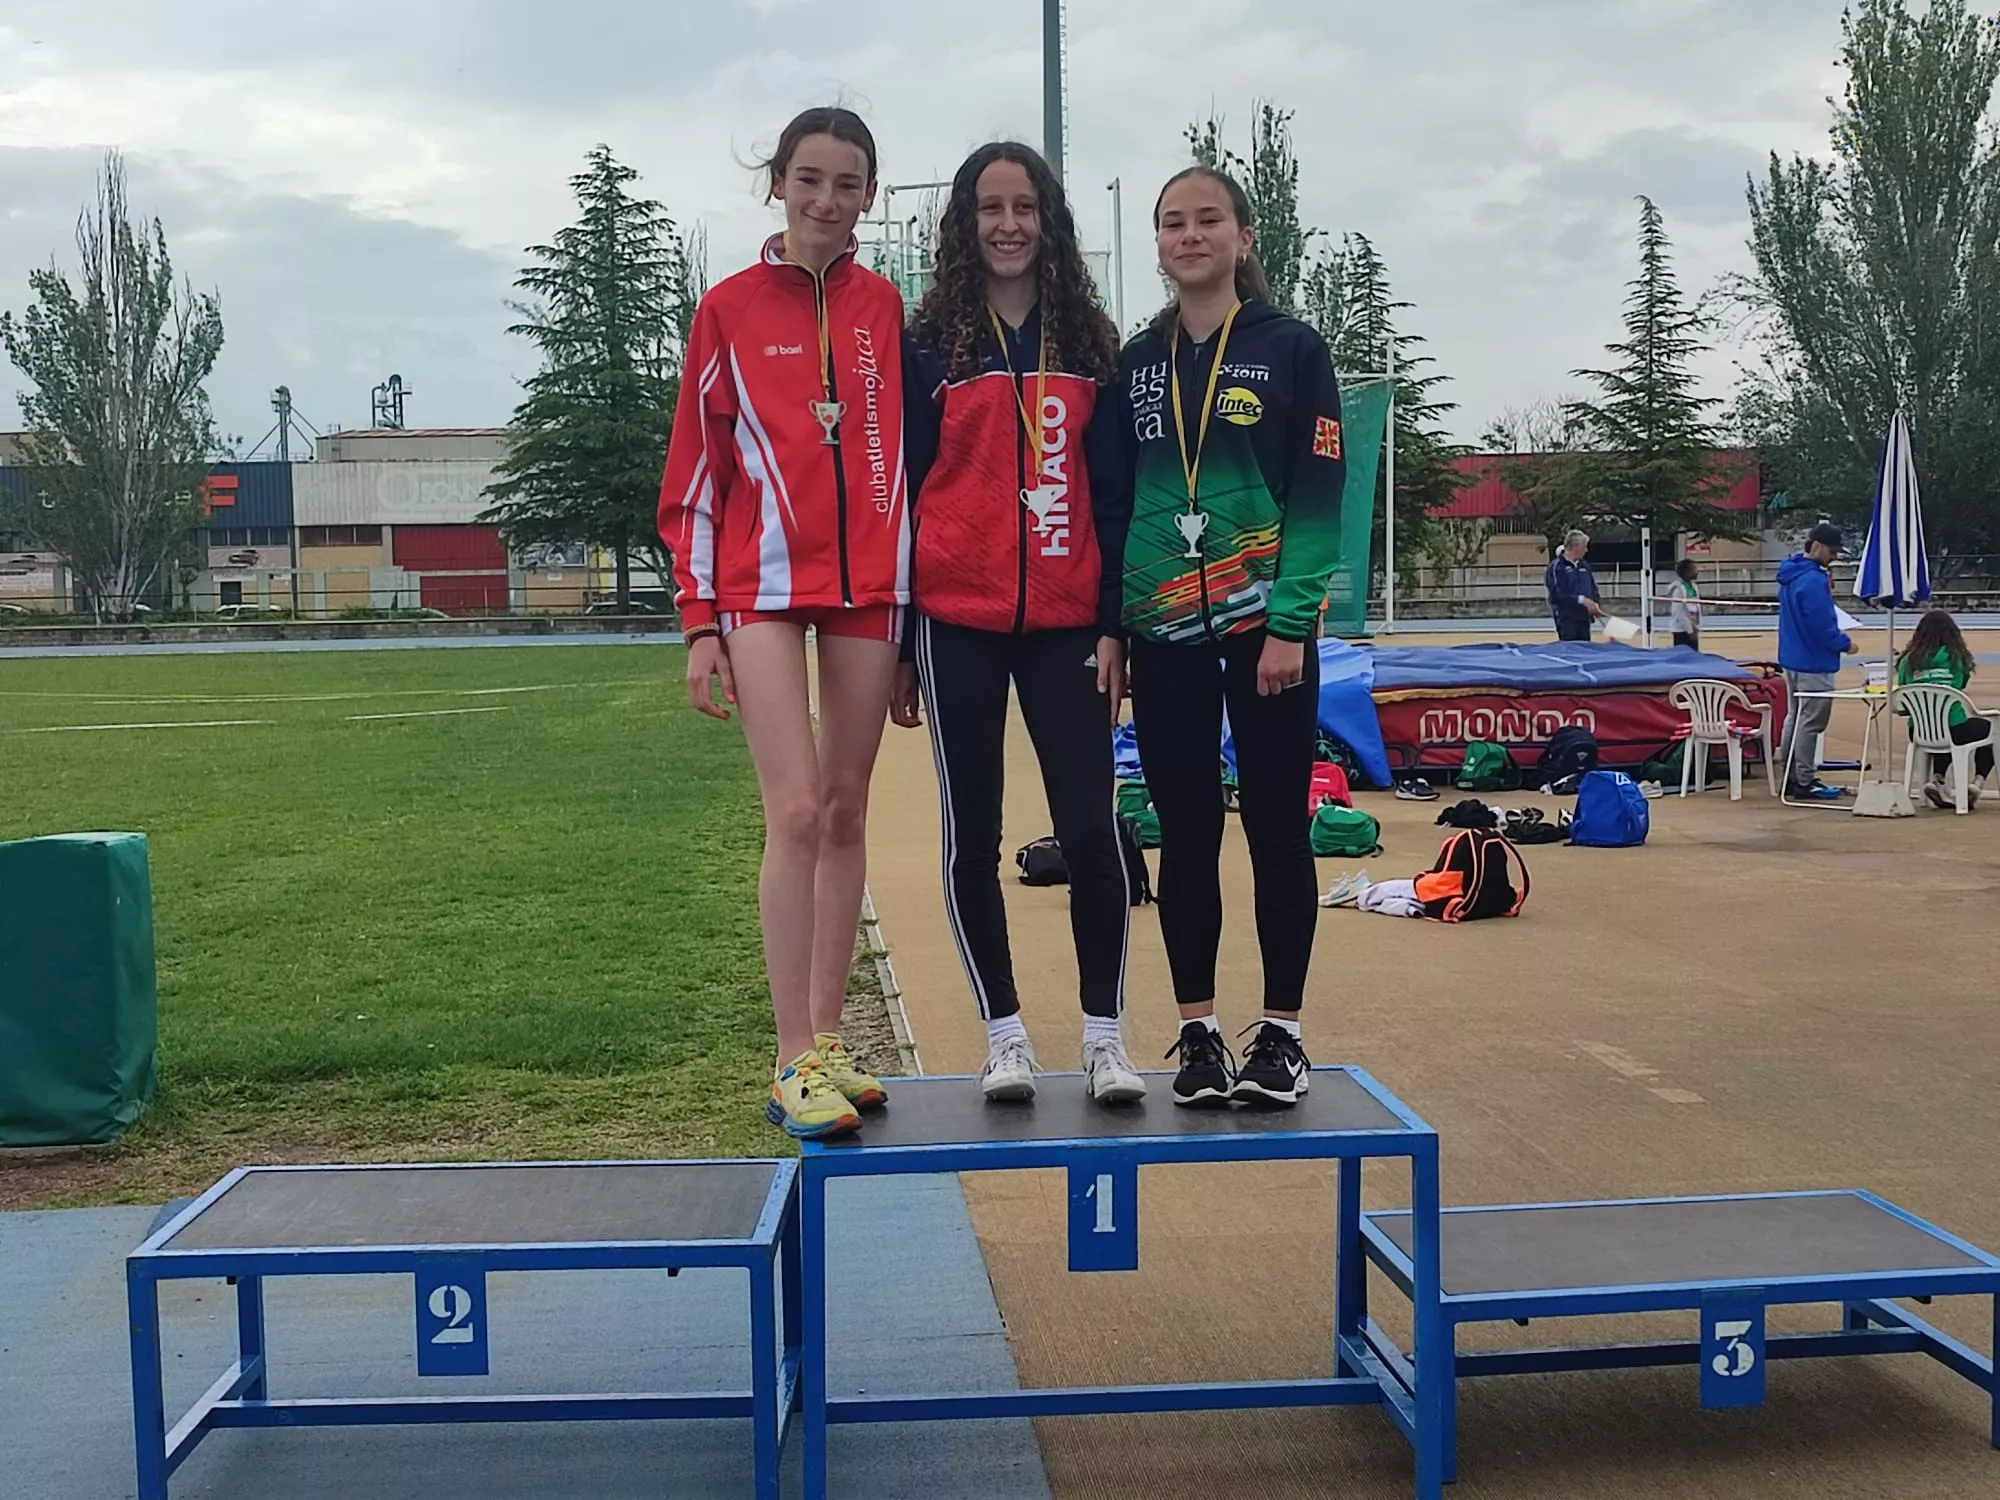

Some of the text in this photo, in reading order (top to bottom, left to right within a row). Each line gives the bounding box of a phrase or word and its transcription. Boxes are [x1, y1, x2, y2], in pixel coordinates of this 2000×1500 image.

[1085, 1174, 1116, 1232] 1
[428, 1285, 474, 1344] 2
[1712, 1320, 1755, 1376] 3
